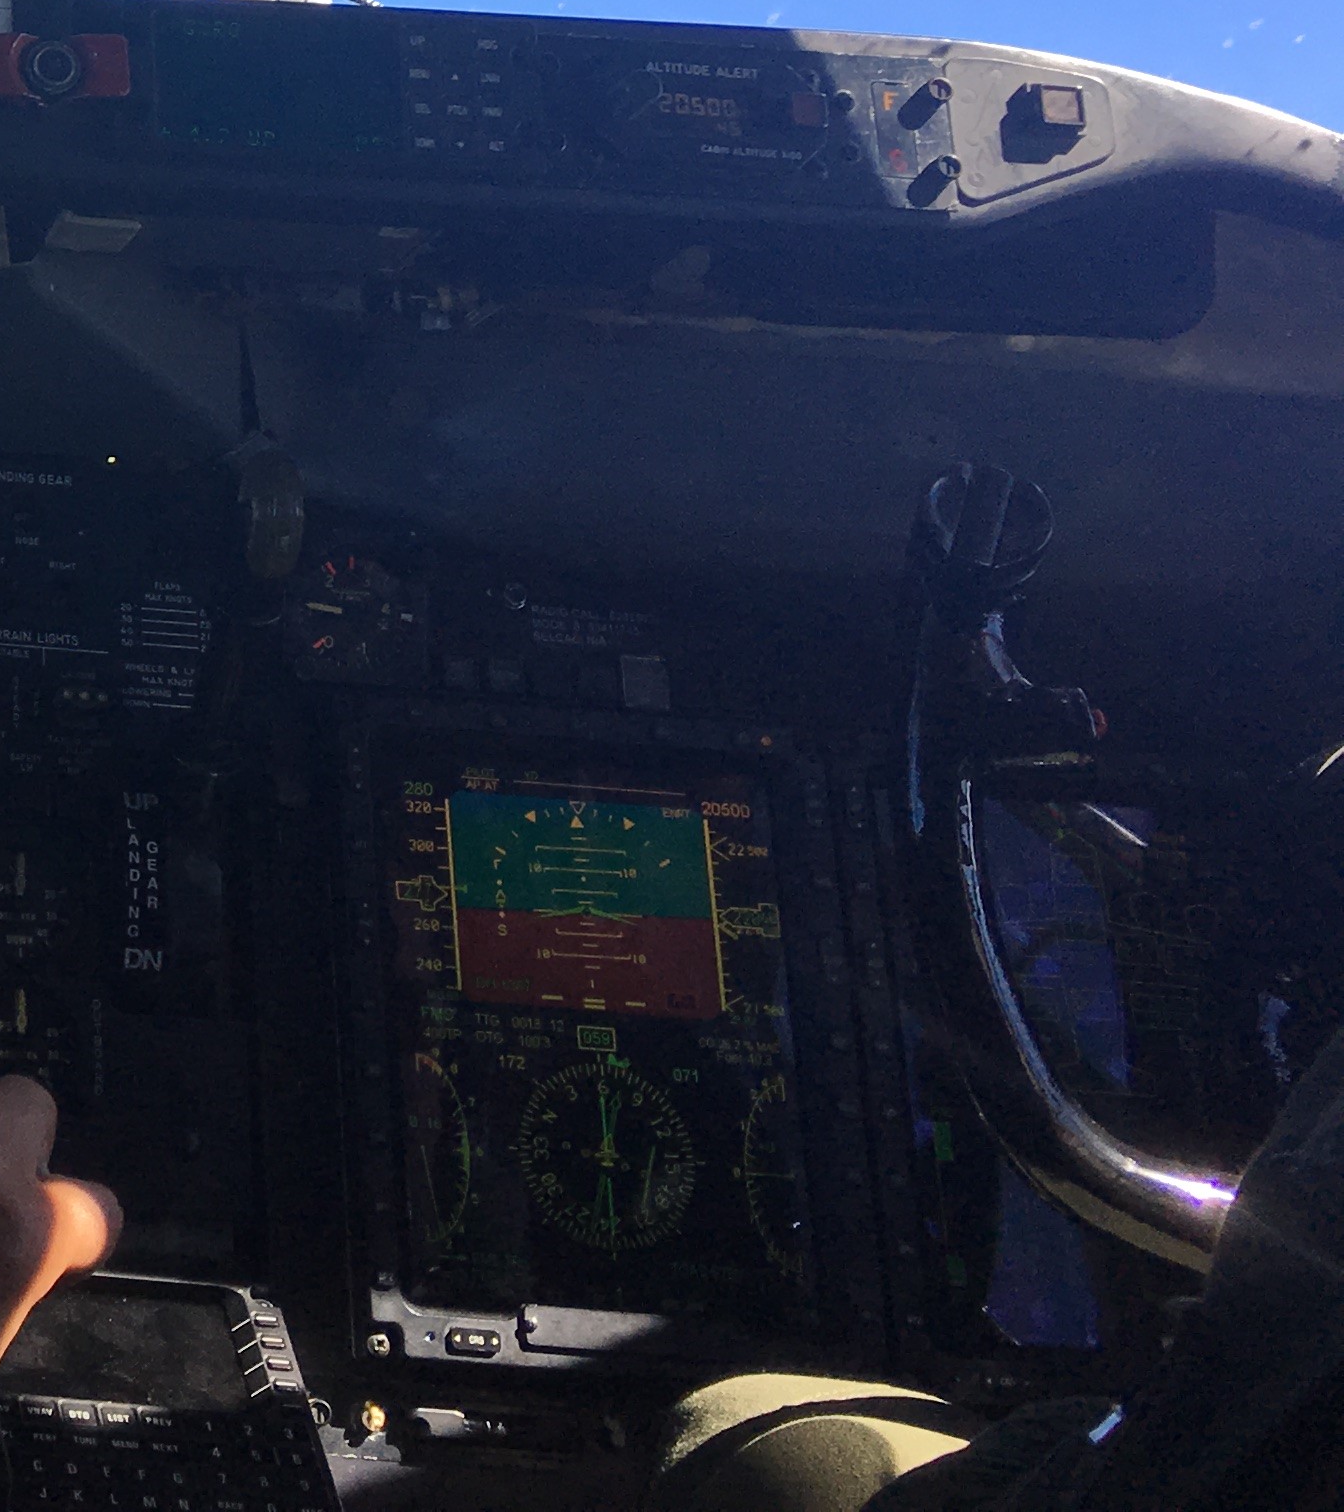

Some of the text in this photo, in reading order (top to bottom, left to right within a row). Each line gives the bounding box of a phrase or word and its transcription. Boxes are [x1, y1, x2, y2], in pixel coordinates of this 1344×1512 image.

[646, 61, 758, 80] ALTITUDE ALERT
[882, 91, 899, 112] F
[39, 474, 72, 486] GEAR
[37, 632, 79, 646] LIGHTS
[123, 791, 159, 811] UP
[127, 817, 140, 938] LANDING
[146, 841, 160, 910] GEAR
[124, 948, 163, 971] DN
[107, 1413, 130, 1423] LIST
[145, 1416, 172, 1427] PREV
